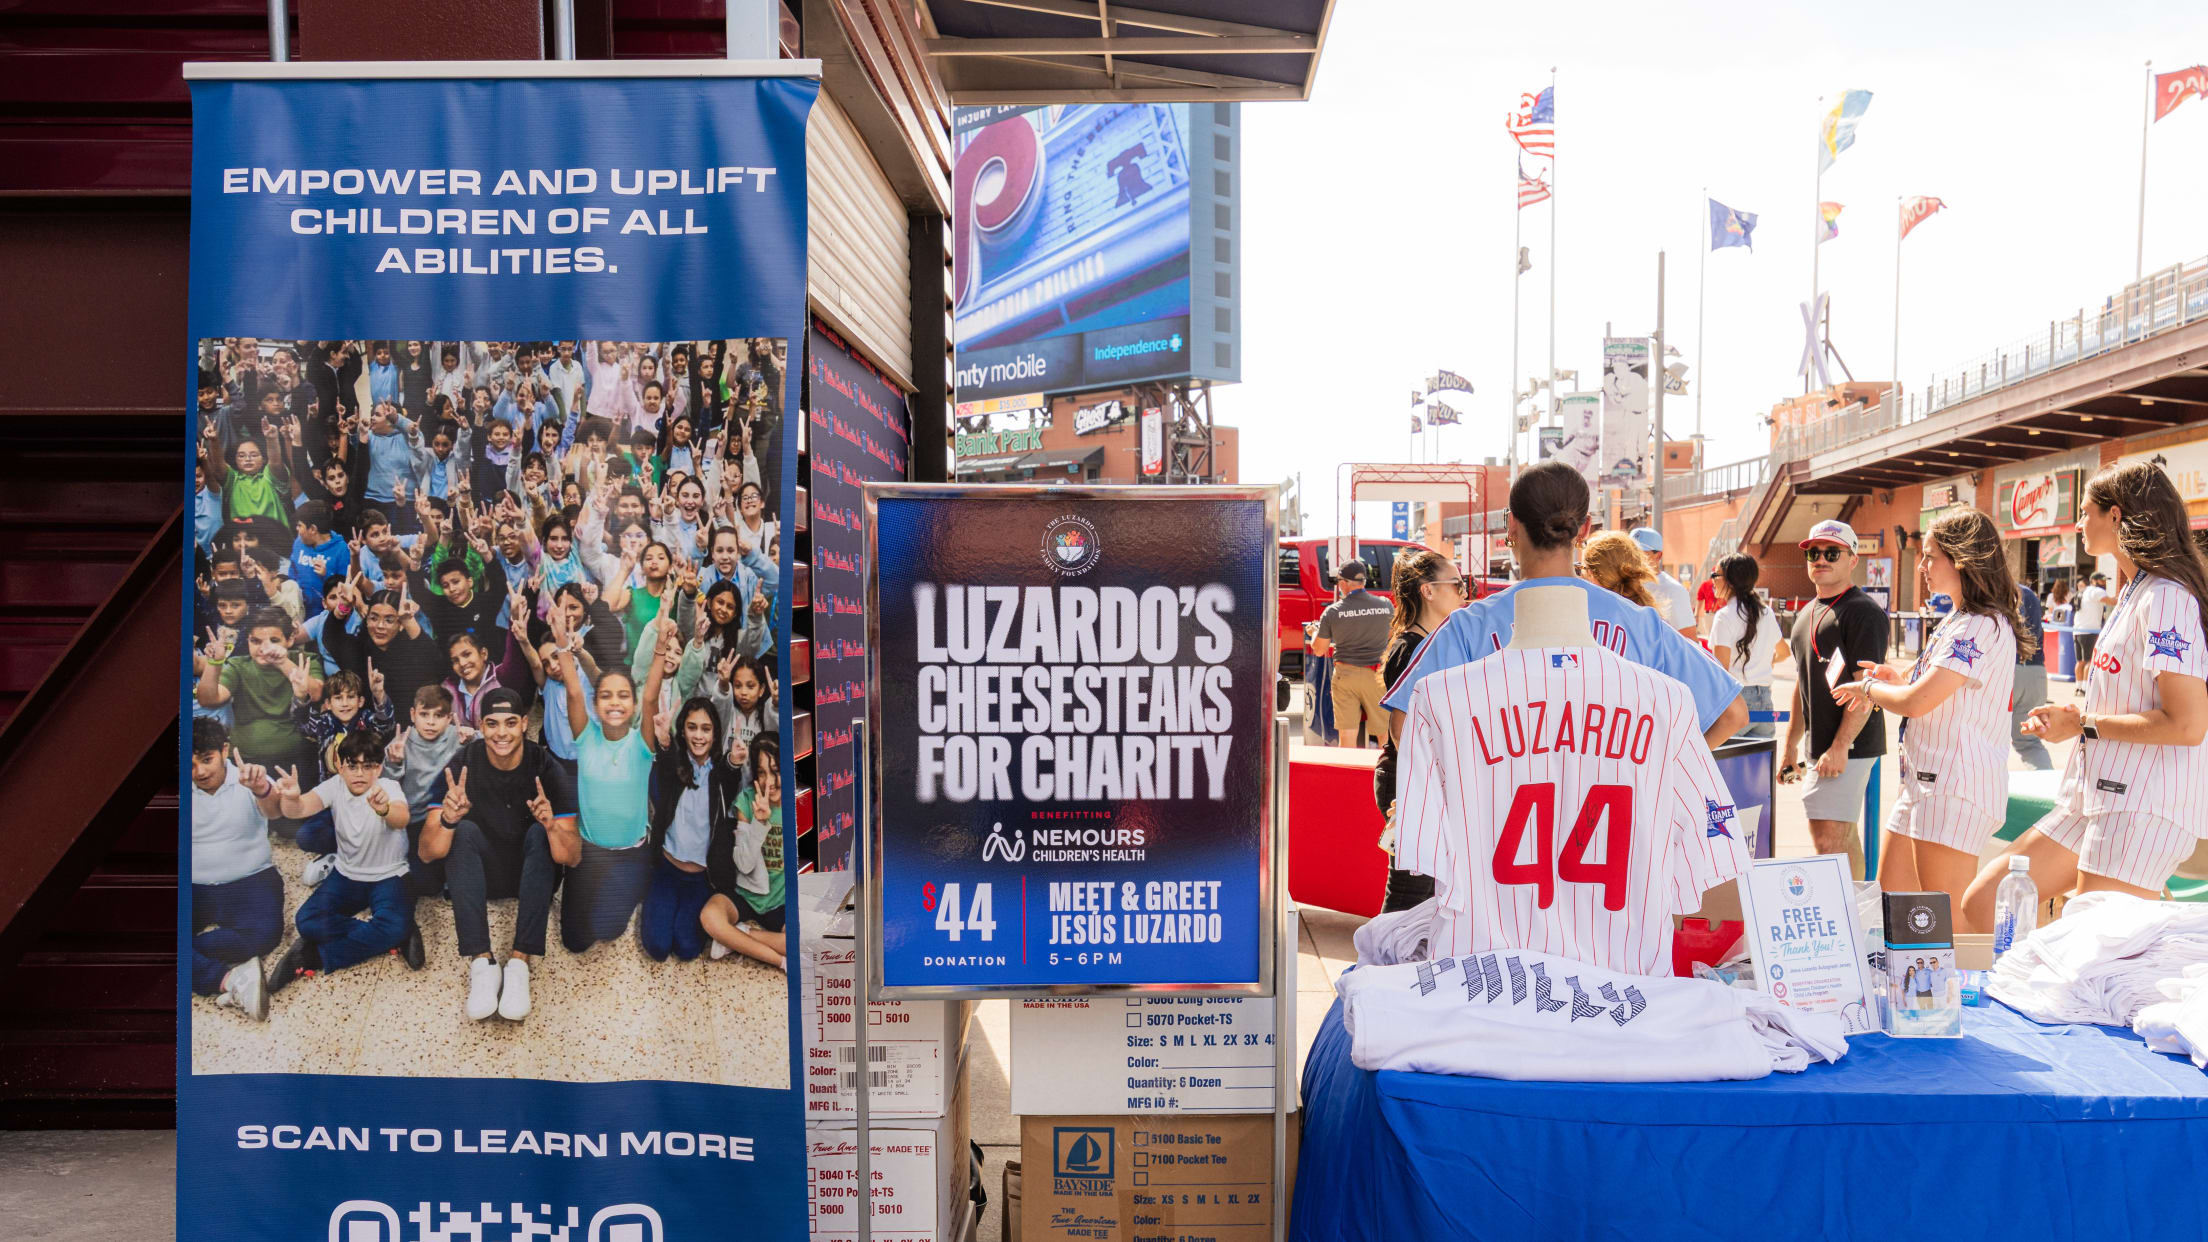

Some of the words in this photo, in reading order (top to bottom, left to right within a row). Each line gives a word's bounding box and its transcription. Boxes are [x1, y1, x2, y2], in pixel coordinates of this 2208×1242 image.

[958, 107, 992, 126] INJURY
[223, 168, 482, 195] EMPOWER
[492, 167, 598, 196] AND
[610, 167, 778, 196] UPLIFT
[289, 208, 537, 236] CHILDREN
[547, 207, 611, 235] OF
[620, 208, 709, 236] ALL
[375, 247, 619, 275] ABILITIES.
[1094, 338, 1168, 361] Independence
[990, 353, 1047, 383] mobile
[956, 428, 999, 457] Bank
[1001, 423, 1043, 453] Park
[1047, 517, 1060, 529] THE
[1061, 514, 1095, 530] LUZARDO
[1040, 548, 1060, 573] FAMILY
[1061, 548, 1101, 577] FOUNDATION
[1339, 607, 1390, 619] PUBLICATIONS
[917, 665, 1233, 733] CHEESESTEAKS
[1472, 701, 1655, 766] LUZARDO
[917, 735, 1013, 801] FOR
[1021, 735, 1233, 801] CHARITY
[1031, 811, 1111, 819] BENEFITTING
[1712, 808, 1733, 820] GAME
[1032, 829, 1145, 846] NEMOURS
[1492, 782, 1634, 914] 44
[1102, 849, 1145, 861] HEALTH
[1049, 882, 1115, 912] MEET
[1121, 881, 1139, 911] &
[1145, 881, 1222, 911] GREET
[1782, 906, 1822, 924] FREE
[1123, 913, 1222, 944] LUZARDO
[1770, 920, 1837, 941] RAFFLE
[1780, 942, 1810, 958] Thank
[1812, 939, 1835, 957] You!
[923, 955, 1007, 967] DONATION
[827, 978, 851, 989] 5040
[827, 996, 851, 1006] 5070
[827, 1014, 851, 1024] 5000
[886, 1013, 910, 1024] 5010
[1147, 1014, 1174, 1026] 5070
[1177, 1013, 1233, 1026] Pocket-TS
[1127, 1036, 1153, 1047] Size:
[1160, 1036, 1167, 1047] S
[1174, 1035, 1184, 1046] M
[1191, 1035, 1197, 1046] L
[1203, 1035, 1217, 1046] XL
[1223, 1034, 1238, 1045] 2X
[1244, 1034, 1258, 1045] 3X
[810, 1048, 832, 1058] Size:
[1127, 1057, 1159, 1068] Color:
[810, 1066, 837, 1076] Color:
[1127, 1077, 1176, 1089] Quantity:
[1180, 1077, 1186, 1088] 6
[1189, 1077, 1222, 1088] Dozen
[809, 1101, 830, 1111] MFG
[1127, 1097, 1151, 1109] MFG
[1169, 1098, 1179, 1109] #:
[237, 1125, 370, 1151] SCAN
[380, 1128, 443, 1154] TO
[454, 1129, 609, 1158] LEARN
[620, 1131, 756, 1162] MORE
[1152, 1134, 1174, 1145] 5100
[1177, 1134, 1203, 1145] Basic
[1206, 1134, 1221, 1145] Tee
[813, 1142, 834, 1152] True
[1152, 1154, 1174, 1165] 7100
[1177, 1154, 1209, 1165] Pocket
[1211, 1154, 1227, 1165] Tee
[819, 1170, 843, 1180] 5040
[1054, 1178, 1113, 1191] BAYSIDE
[820, 1188, 844, 1198] 5070
[1134, 1195, 1156, 1205] Size:
[1162, 1194, 1174, 1205] XS
[1182, 1194, 1189, 1205] S
[1197, 1194, 1206, 1205] M
[1214, 1194, 1220, 1205] L
[1228, 1194, 1240, 1205] XL
[1247, 1194, 1260, 1205] 2X
[820, 1205, 844, 1215] 5000
[878, 1204, 903, 1215] 5010
[1074, 1215, 1118, 1225] American
[1134, 1215, 1161, 1226] Color:
[1067, 1229, 1091, 1237] MADE
[1093, 1229, 1109, 1237] TEE
